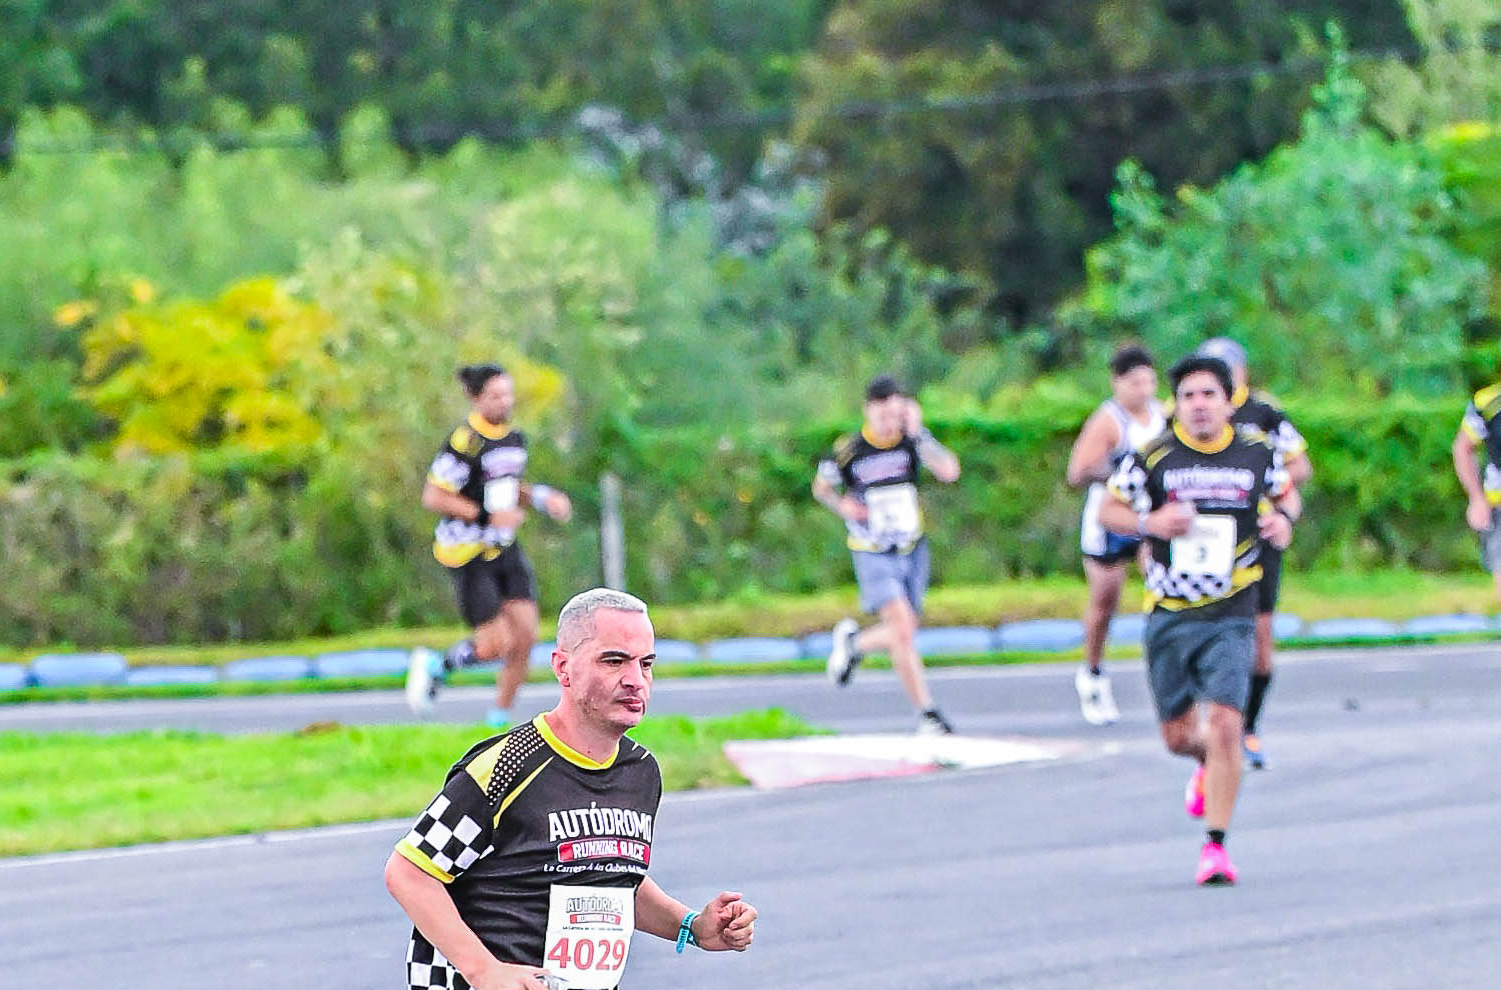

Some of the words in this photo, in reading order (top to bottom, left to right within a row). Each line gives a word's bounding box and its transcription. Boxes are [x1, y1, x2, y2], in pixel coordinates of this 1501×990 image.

[548, 801, 652, 842] AUTÓDROMO
[572, 840, 618, 859] RUNNING
[619, 841, 645, 861] RACE
[547, 938, 626, 971] 4029
